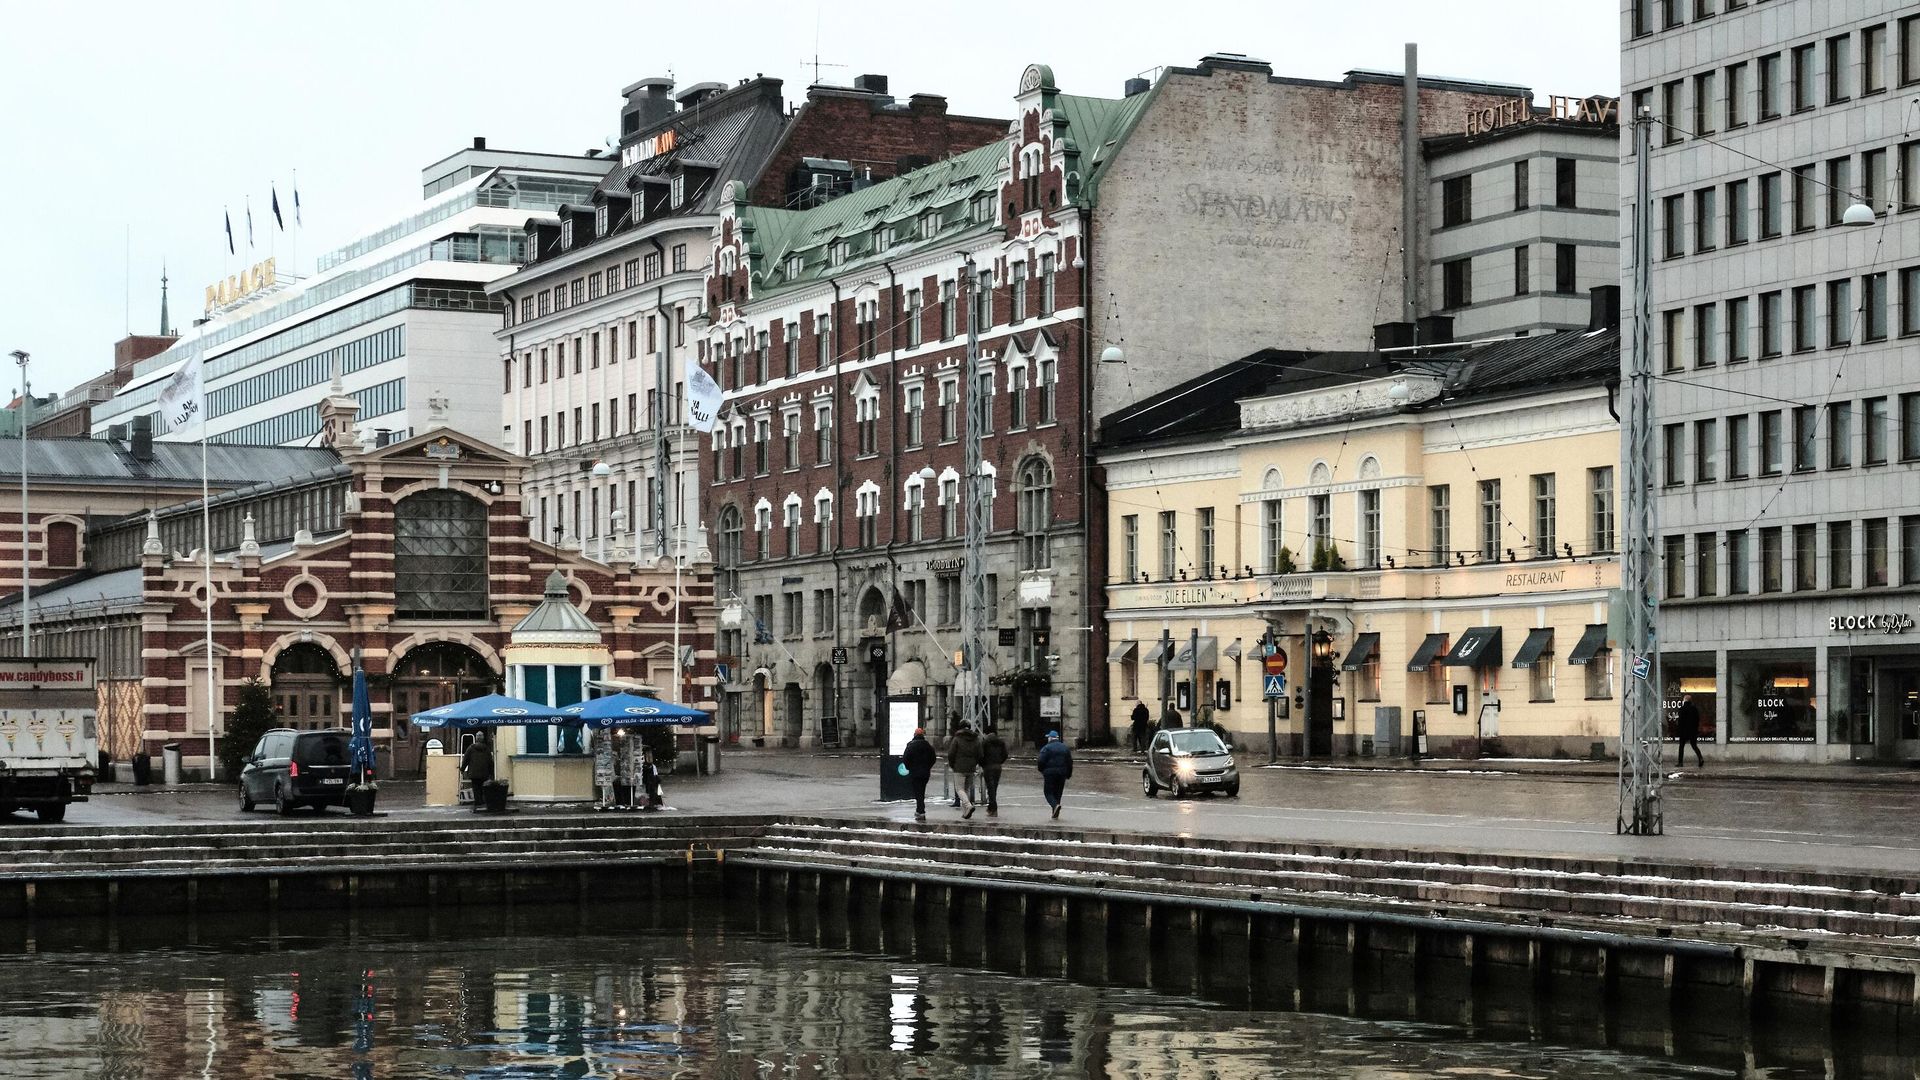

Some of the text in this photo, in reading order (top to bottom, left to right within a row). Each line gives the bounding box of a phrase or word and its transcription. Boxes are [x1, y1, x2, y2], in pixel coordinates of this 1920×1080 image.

[1465, 97, 1530, 137] HOTEL
[205, 256, 276, 313] PALACE
[1505, 570, 1566, 586] RESTAURANT
[1165, 590, 1179, 604] SUE
[1182, 588, 1207, 603] ELLEN
[1829, 615, 1876, 630] BLOCK
[1757, 699, 1784, 707] BLOCK
